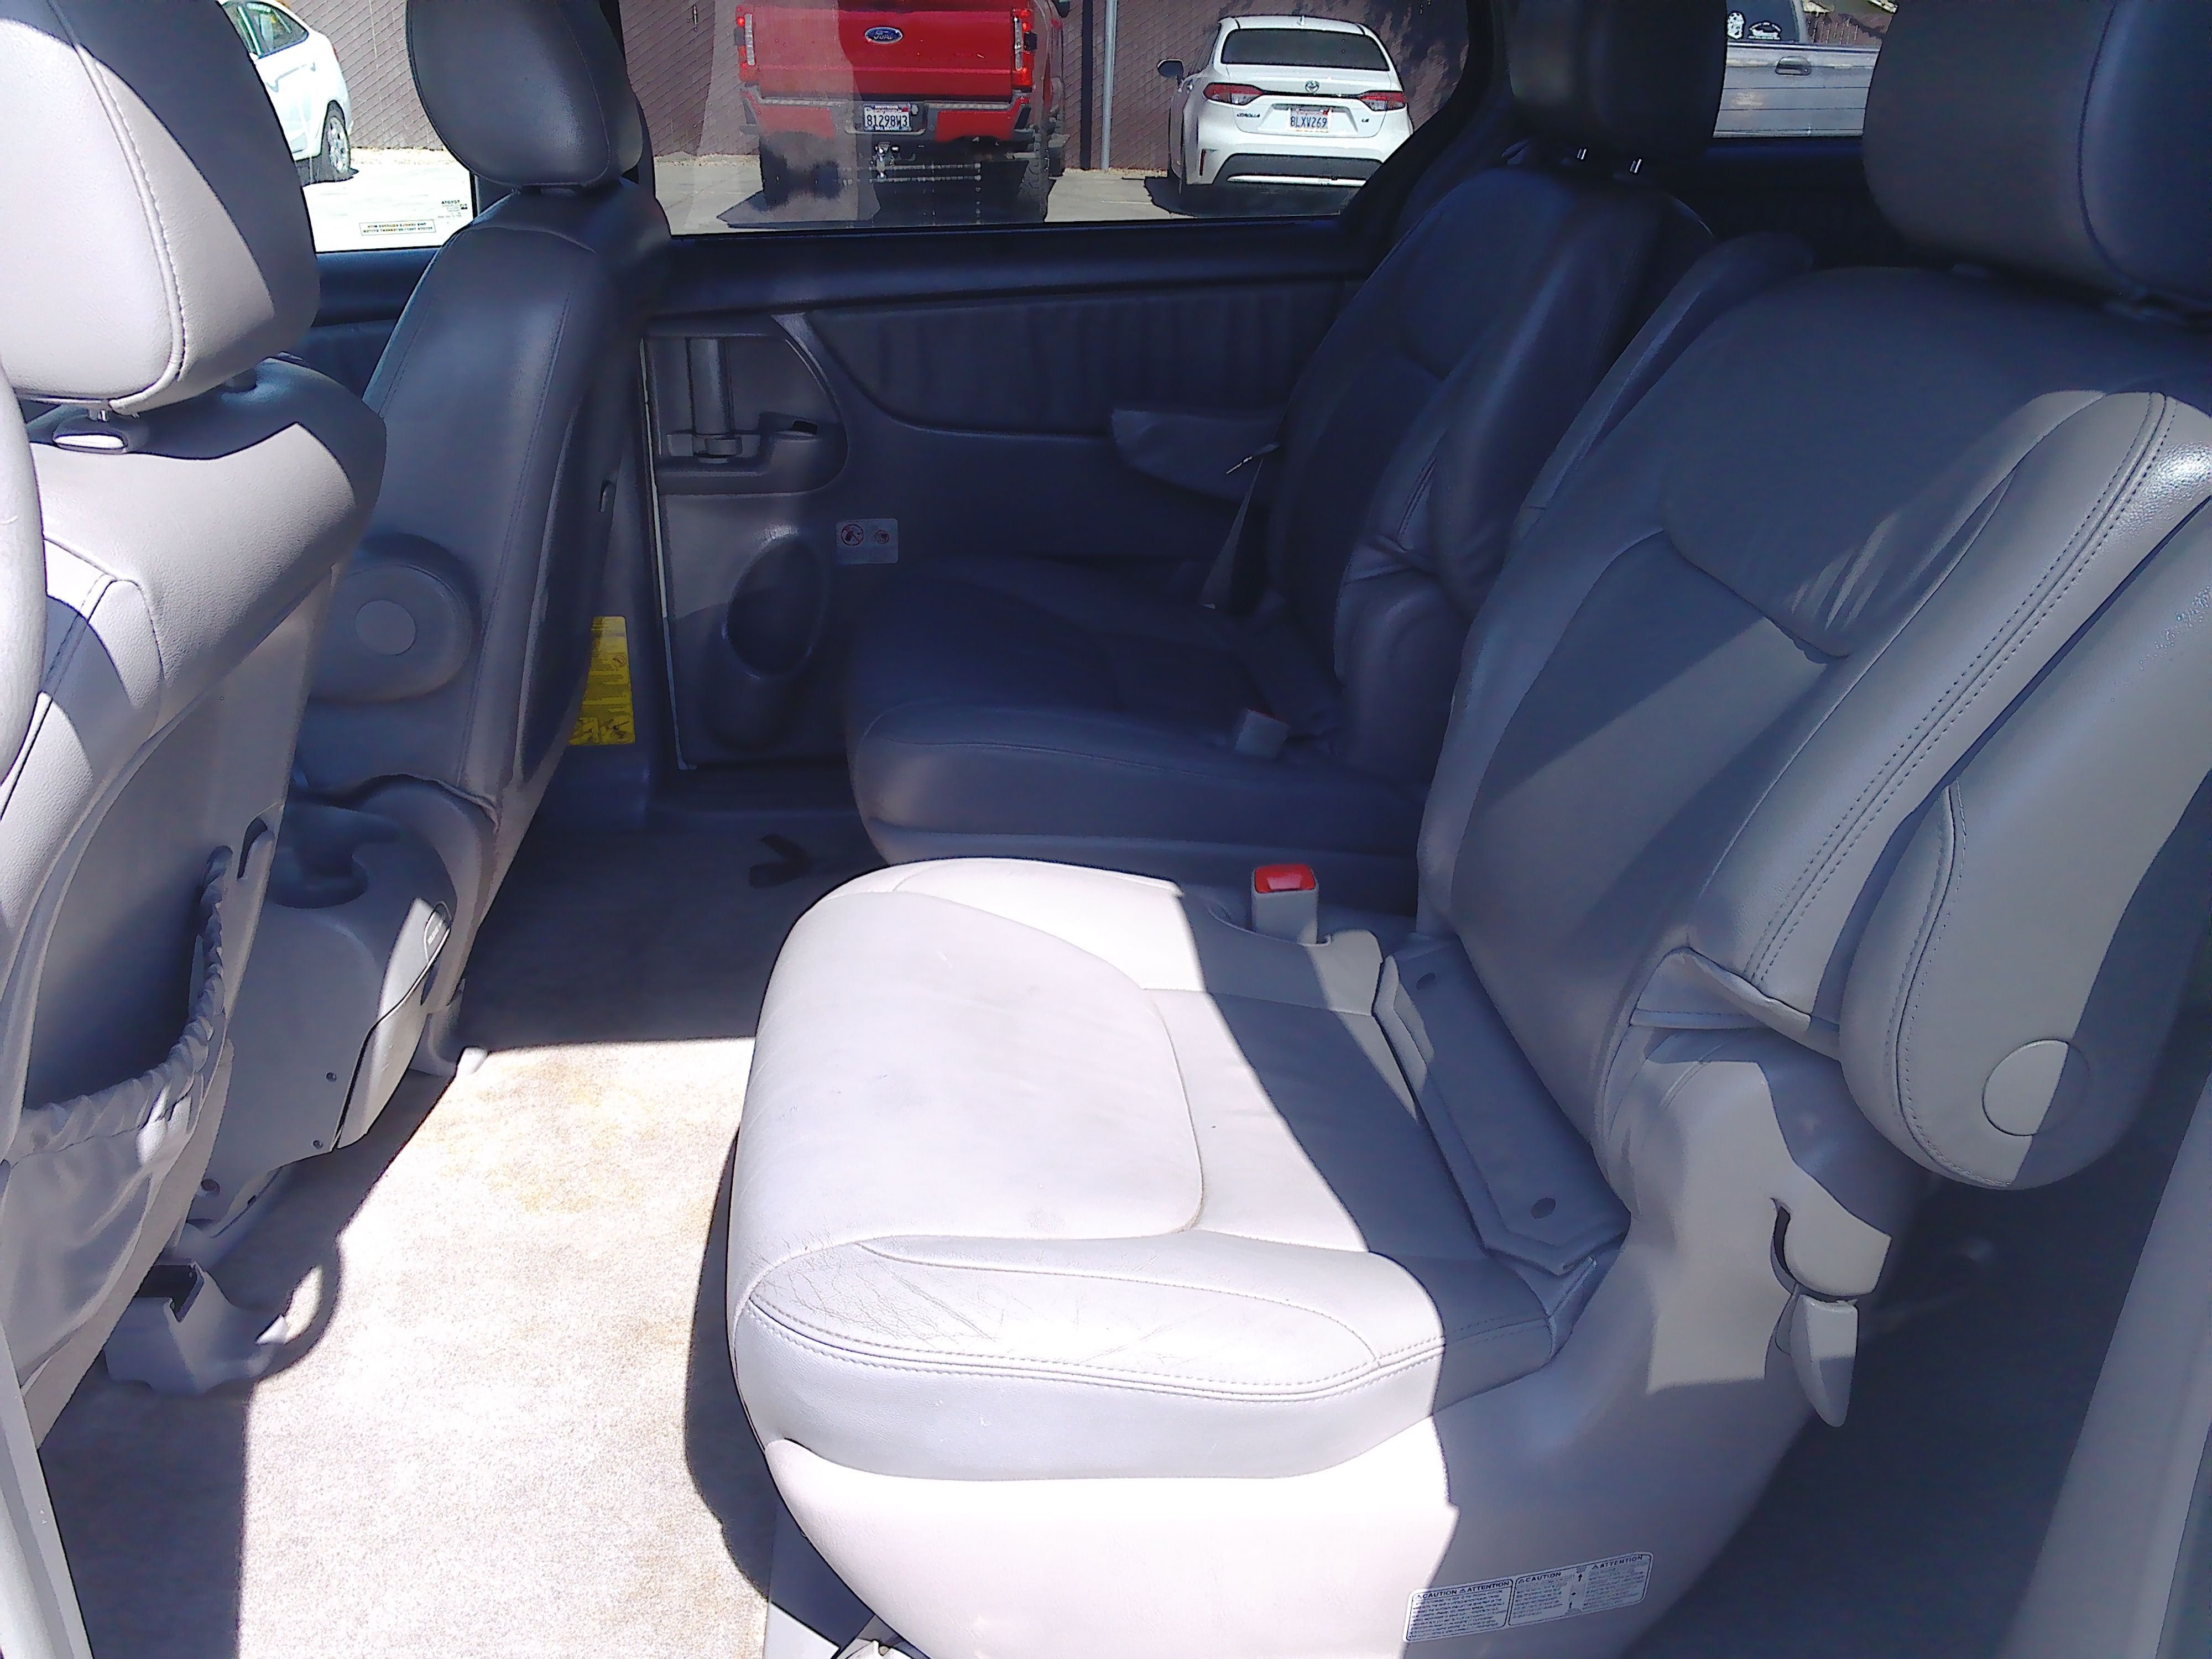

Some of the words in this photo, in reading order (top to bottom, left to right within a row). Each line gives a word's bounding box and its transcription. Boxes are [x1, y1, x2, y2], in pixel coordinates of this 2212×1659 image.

[1291, 116, 1327, 128] 8LXV269
[1525, 1572, 1561, 1582] CAUTION
[1422, 1589, 1457, 1599] CAUTION
[1467, 1580, 1509, 1593] ATTENTION
